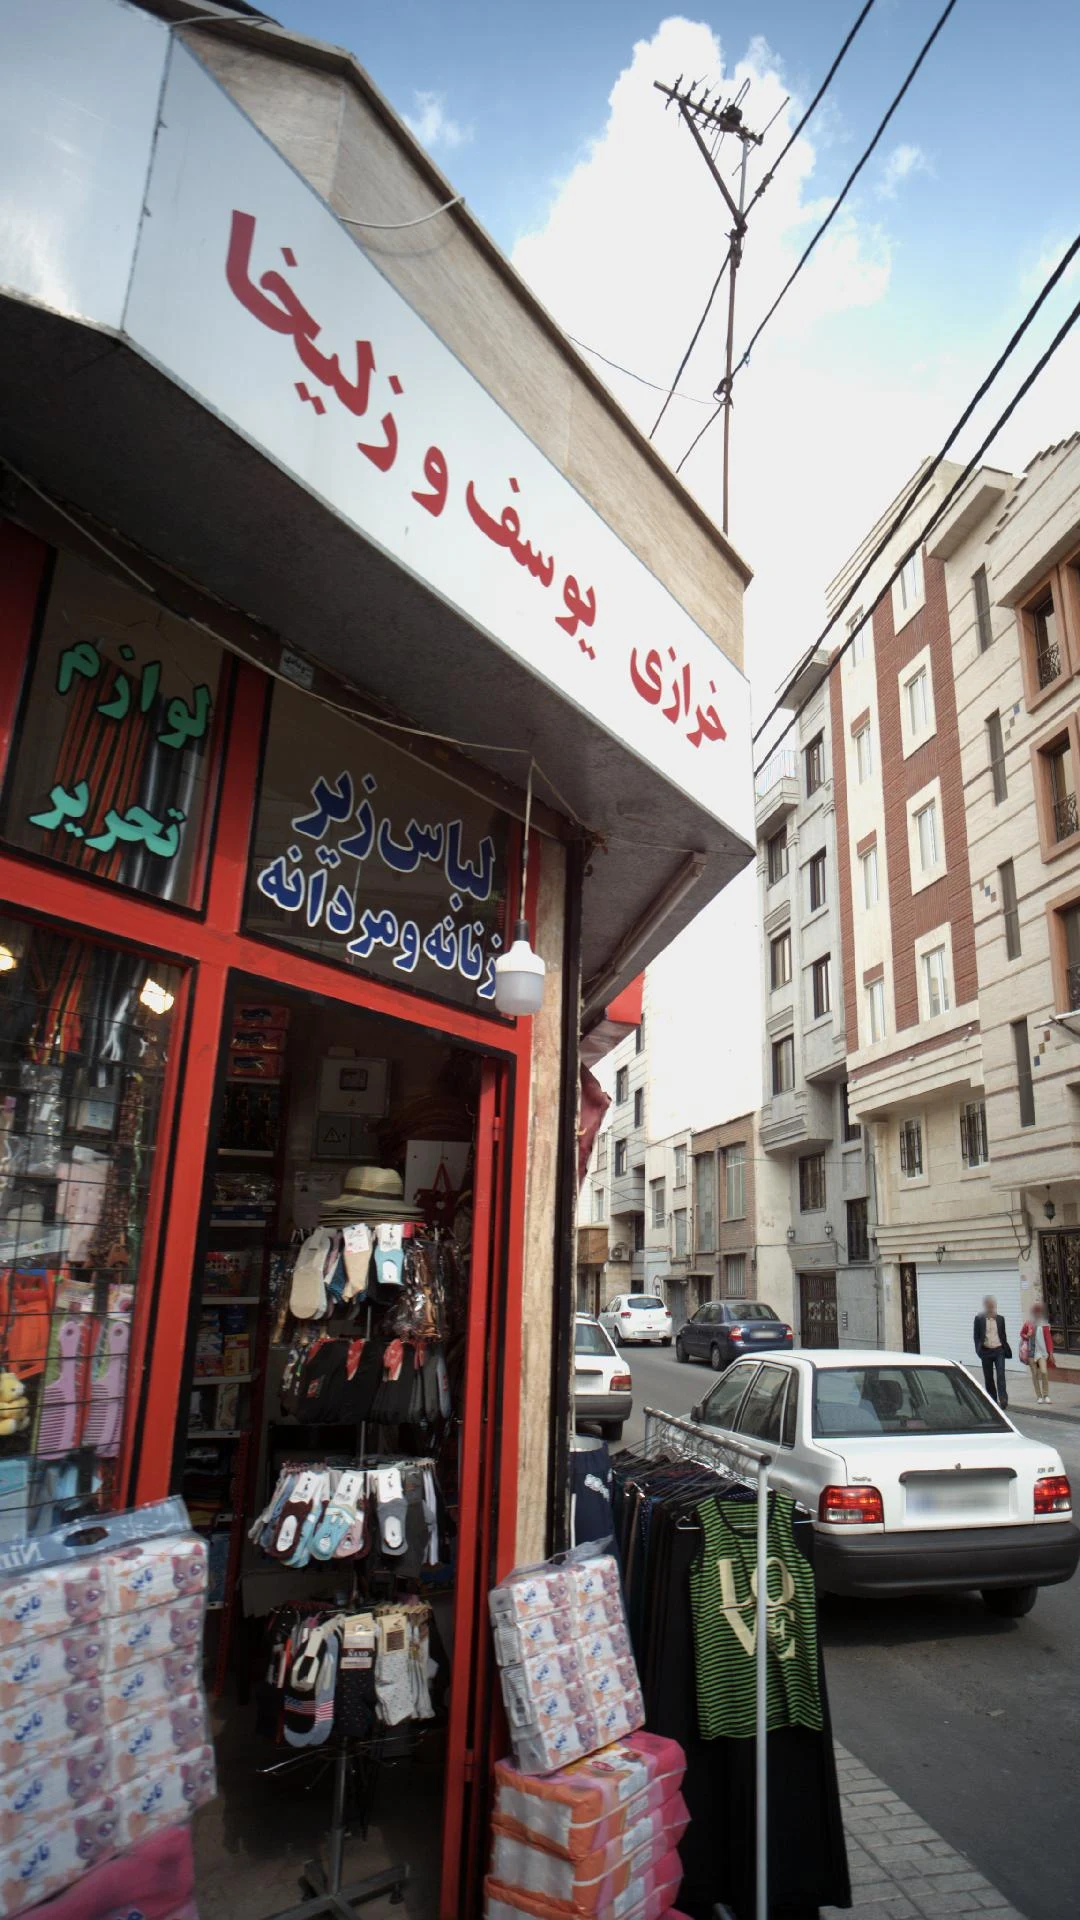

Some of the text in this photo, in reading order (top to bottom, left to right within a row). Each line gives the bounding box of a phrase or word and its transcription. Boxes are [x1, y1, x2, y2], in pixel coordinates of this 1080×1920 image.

[226, 211, 728, 749] خرازی یوسف و زلیخا
[56, 641, 211, 750] لوازم
[27, 780, 186, 859] تحریر
[292, 770, 495, 912] لباس زیر
[257, 845, 502, 999] زنانه و مردانه
